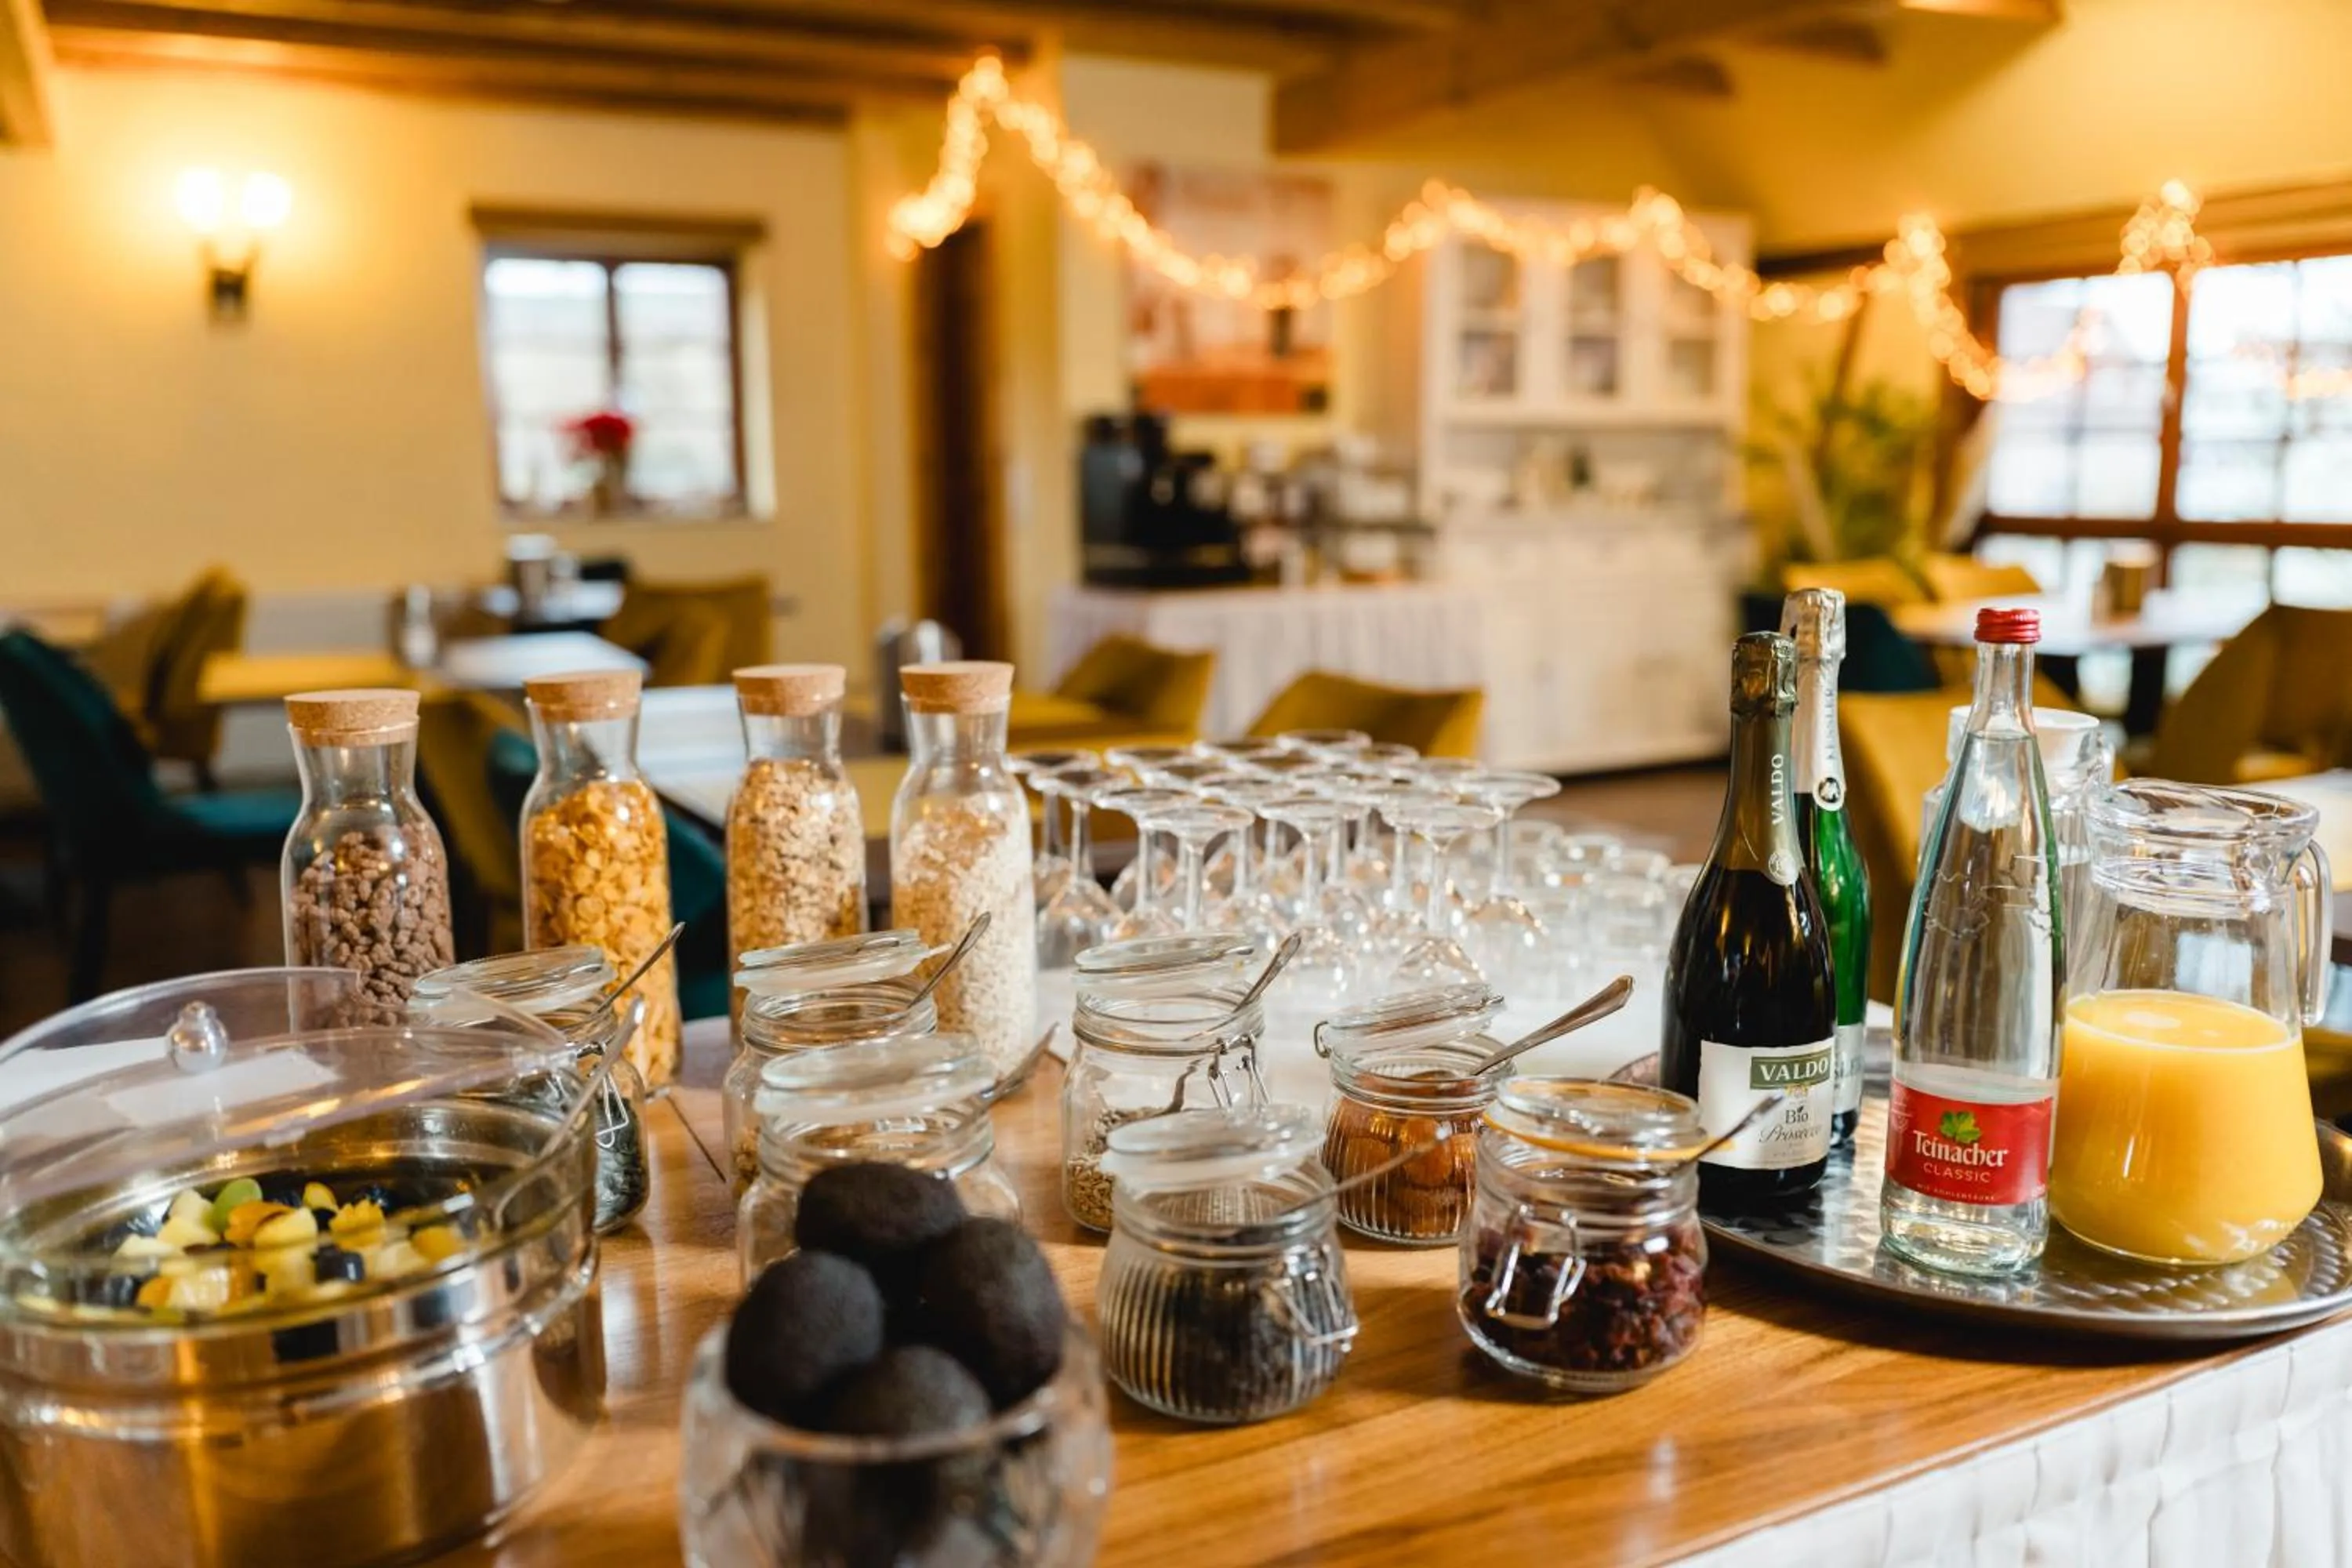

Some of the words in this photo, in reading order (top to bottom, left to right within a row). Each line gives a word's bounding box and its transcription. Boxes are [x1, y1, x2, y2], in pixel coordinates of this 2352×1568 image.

[1771, 753, 1784, 826] VALDO
[1760, 1057, 1828, 1081] VALDO
[1785, 1105, 1809, 1124] Bio
[1913, 1130, 2009, 1167] Teinacher
[1923, 1162, 1991, 1184] CLASSIC
